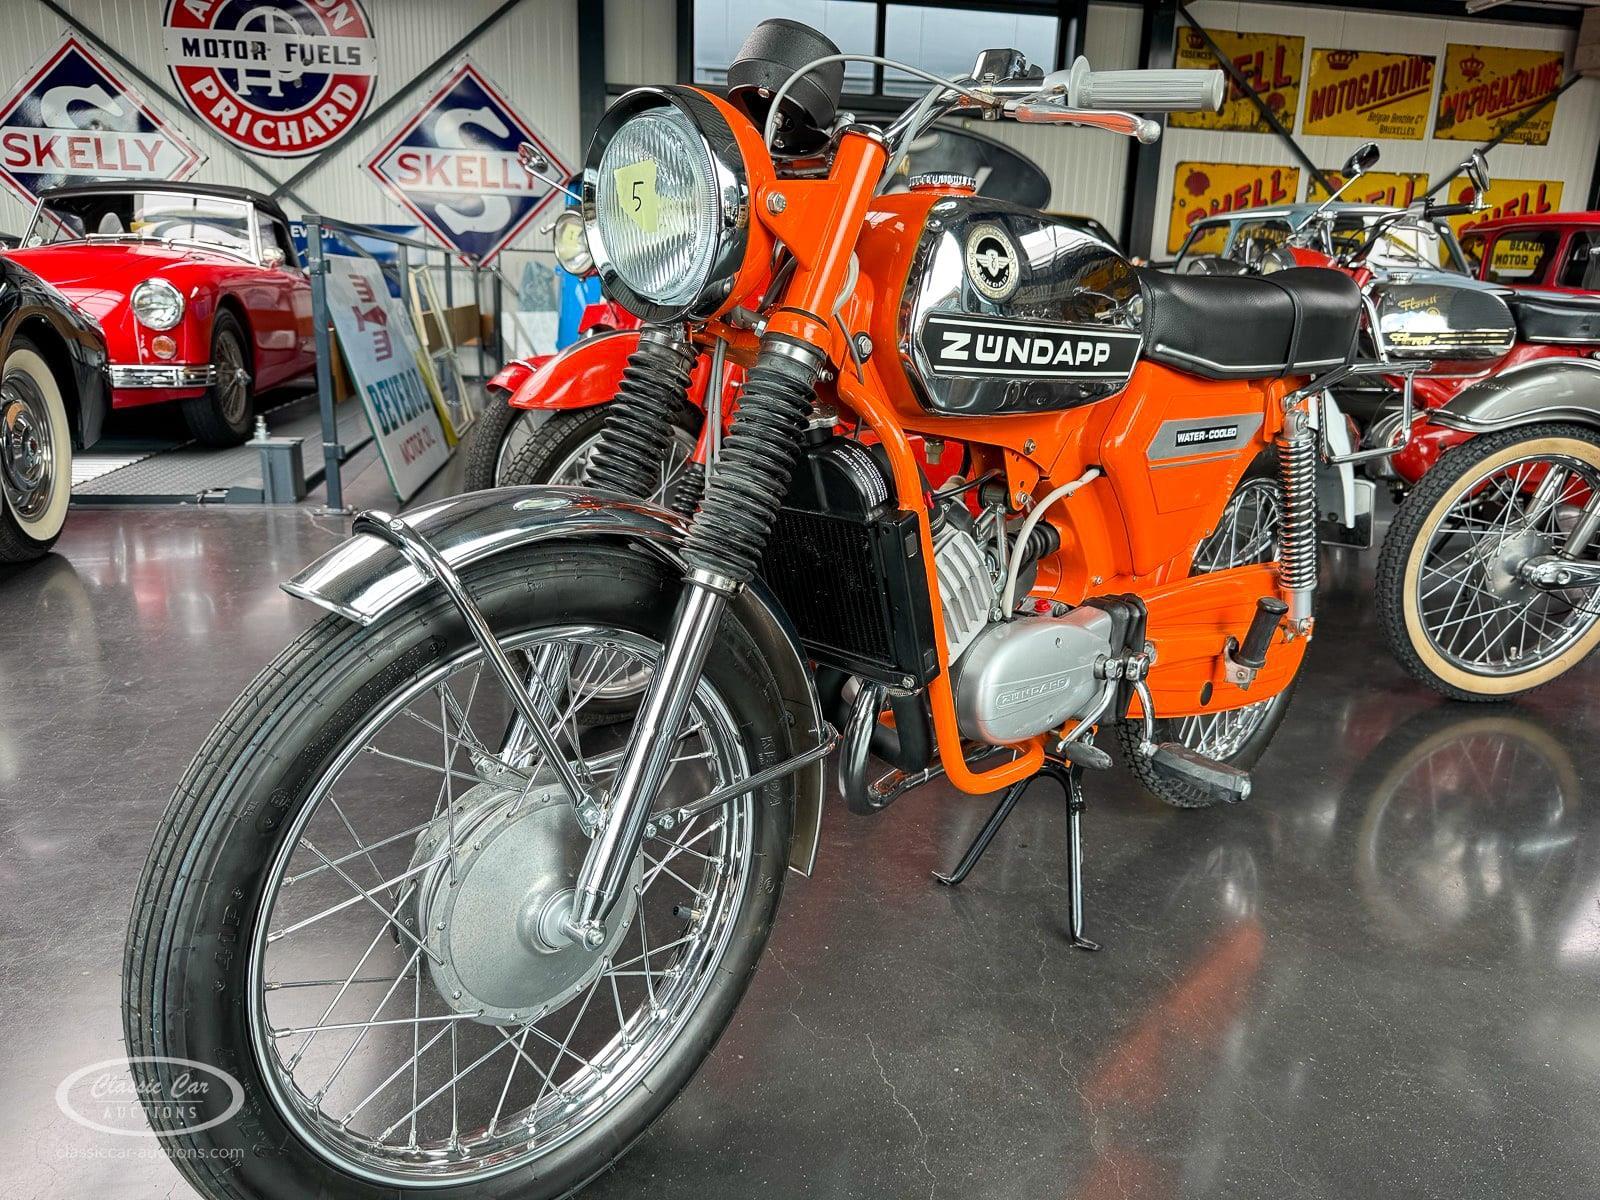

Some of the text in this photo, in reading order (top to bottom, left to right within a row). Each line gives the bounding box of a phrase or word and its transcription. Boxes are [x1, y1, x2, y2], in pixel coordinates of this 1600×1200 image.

[181, 37, 361, 66] MOTOR FUELS
[1308, 56, 1432, 123] MOTOGAZOLINE
[190, 75, 359, 146] PRICHARD
[2, 132, 164, 173] SKELLY
[632, 181, 643, 213] 5
[940, 331, 1111, 367] ZÜNDAPP
[1177, 427, 1238, 443] WATER-COOLED
